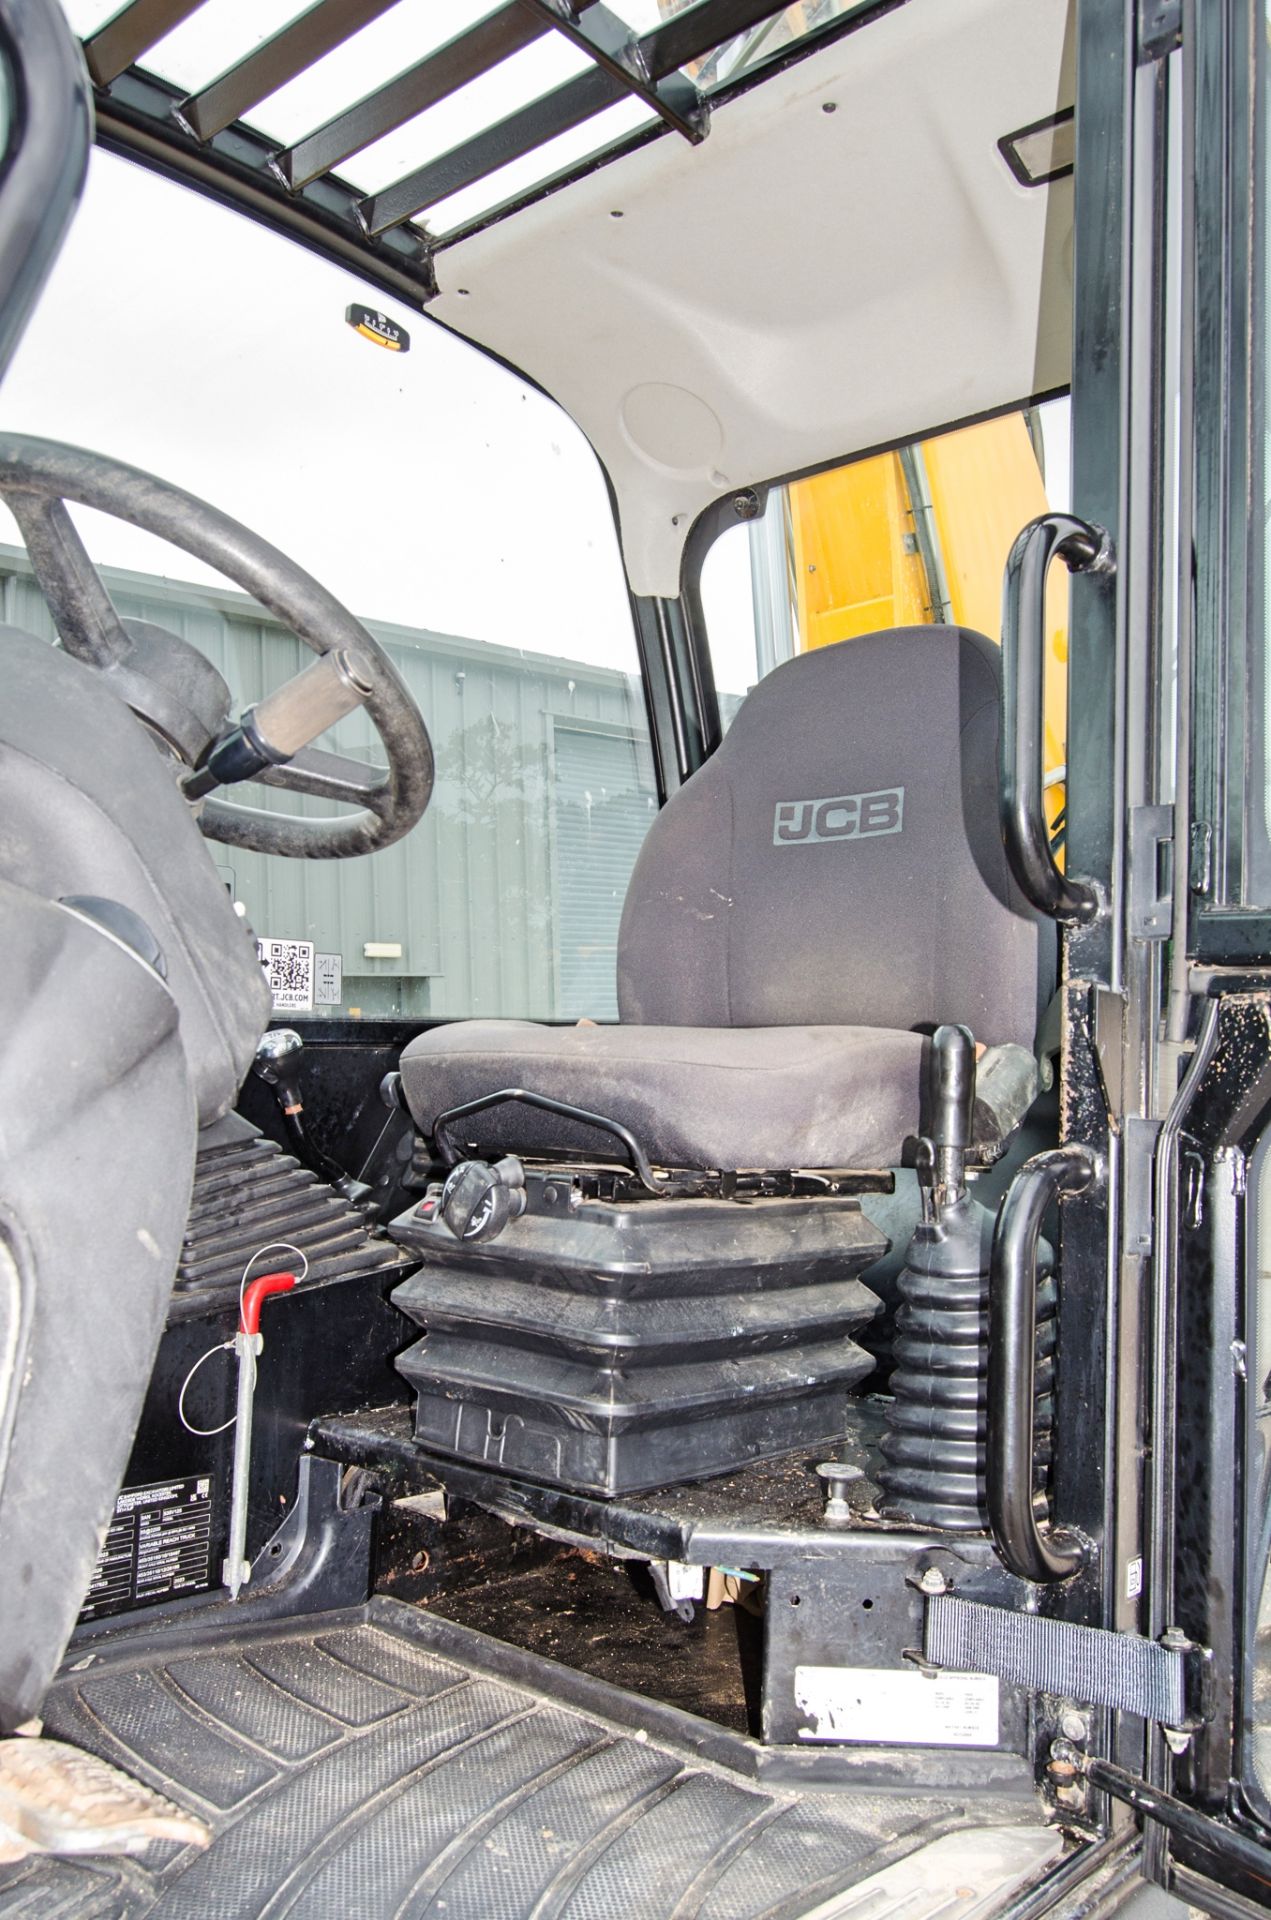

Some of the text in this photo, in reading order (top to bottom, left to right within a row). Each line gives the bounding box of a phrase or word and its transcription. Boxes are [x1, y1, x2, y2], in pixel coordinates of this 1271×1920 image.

[778, 792, 900, 841] JCB
[163, 1536, 180, 1544] REACH
[180, 1533, 196, 1541] TRUCK
